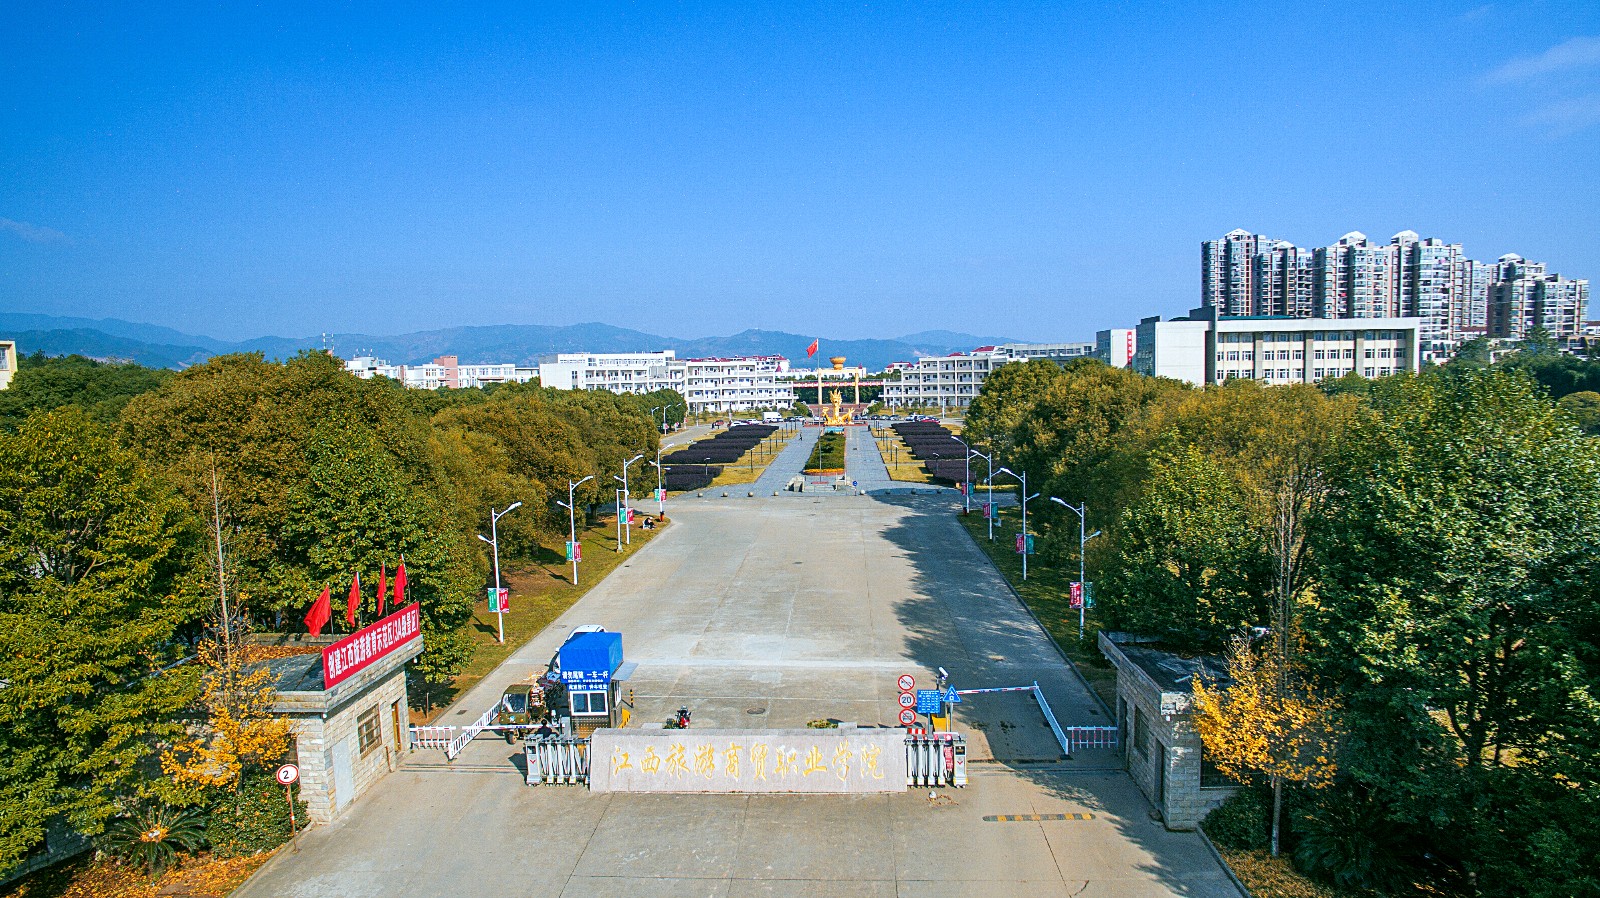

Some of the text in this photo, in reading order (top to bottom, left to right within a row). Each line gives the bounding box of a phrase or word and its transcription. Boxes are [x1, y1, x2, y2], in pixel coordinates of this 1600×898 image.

[901, 696, 912, 704] 20
[611, 740, 884, 781] 江西旅游商贸职业学院
